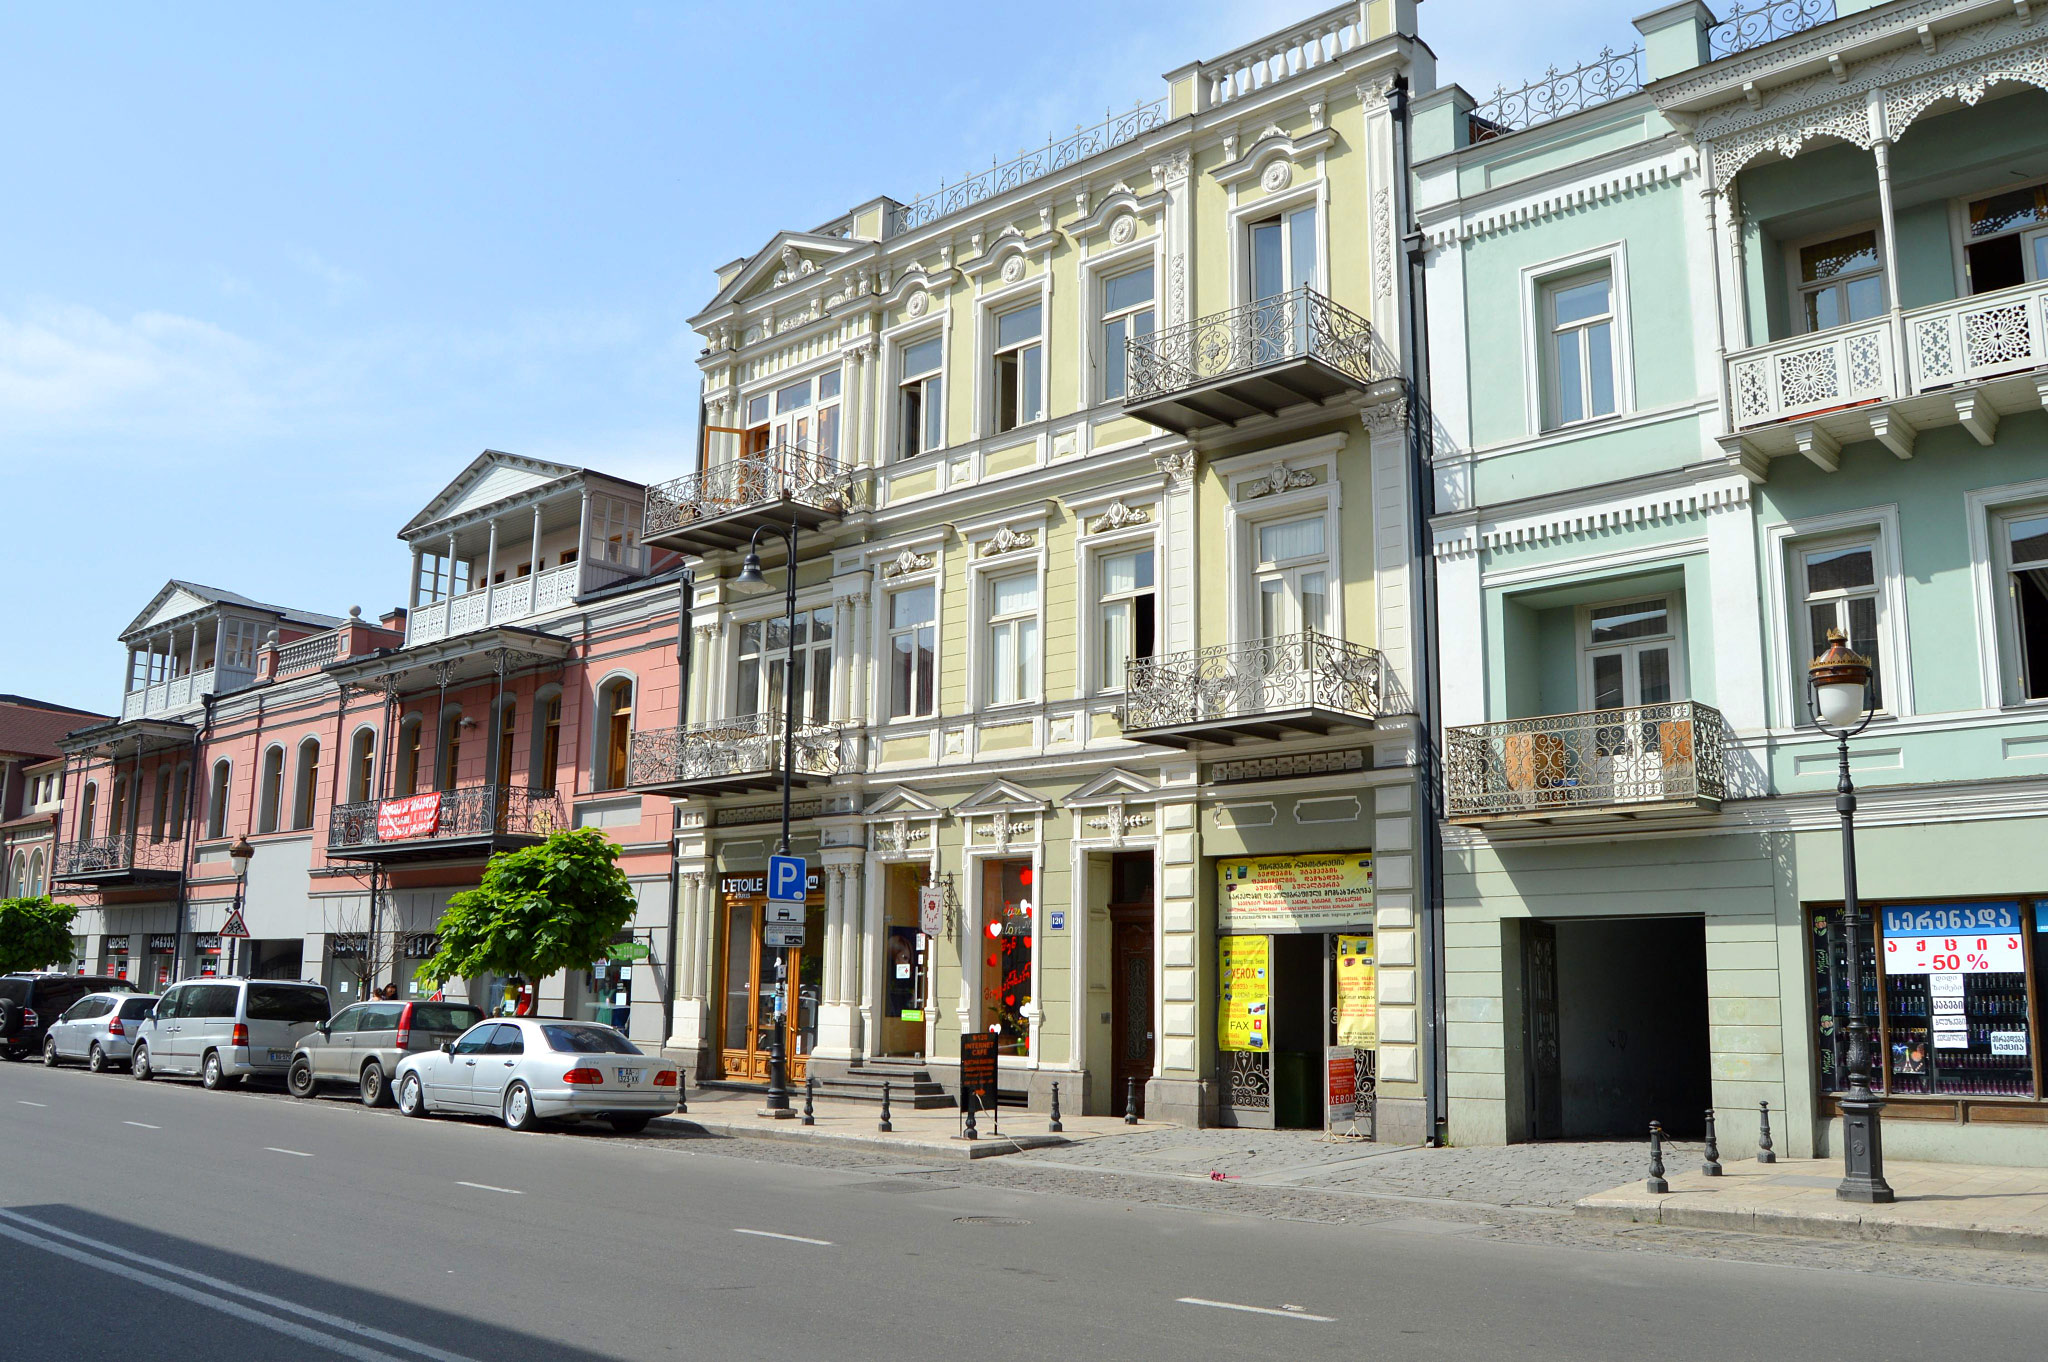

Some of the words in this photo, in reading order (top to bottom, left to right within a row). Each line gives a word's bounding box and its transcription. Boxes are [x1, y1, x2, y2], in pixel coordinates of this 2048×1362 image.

[1052, 917, 1063, 925] 120
[1888, 908, 2011, 931] სერენადა
[1231, 967, 1256, 979] XEROX
[1933, 1000, 1964, 1010] კაბები
[1230, 1021, 1249, 1030] FAX
[1331, 1093, 1354, 1105] XEROX
